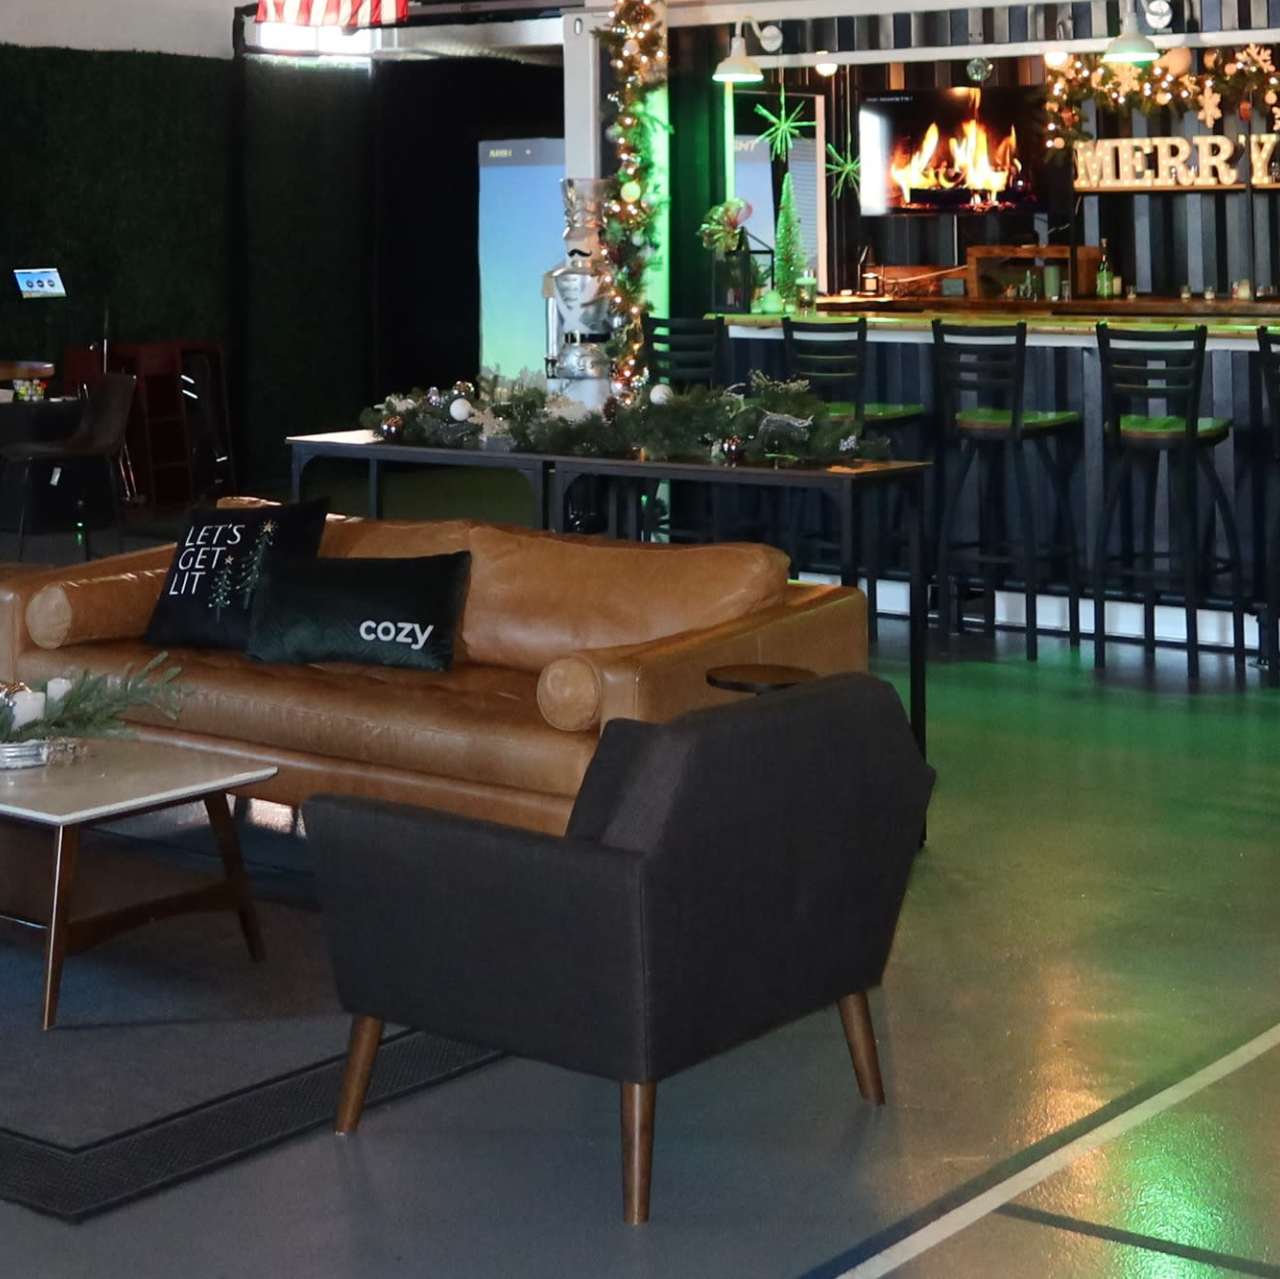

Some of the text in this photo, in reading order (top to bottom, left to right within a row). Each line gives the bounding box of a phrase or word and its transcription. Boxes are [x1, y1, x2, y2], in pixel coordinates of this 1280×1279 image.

[1073, 134, 1280, 187] MERRY
[185, 524, 245, 547] LET'S
[179, 547, 226, 570] GET
[170, 572, 206, 595] LIT
[360, 620, 434, 650] cozy
